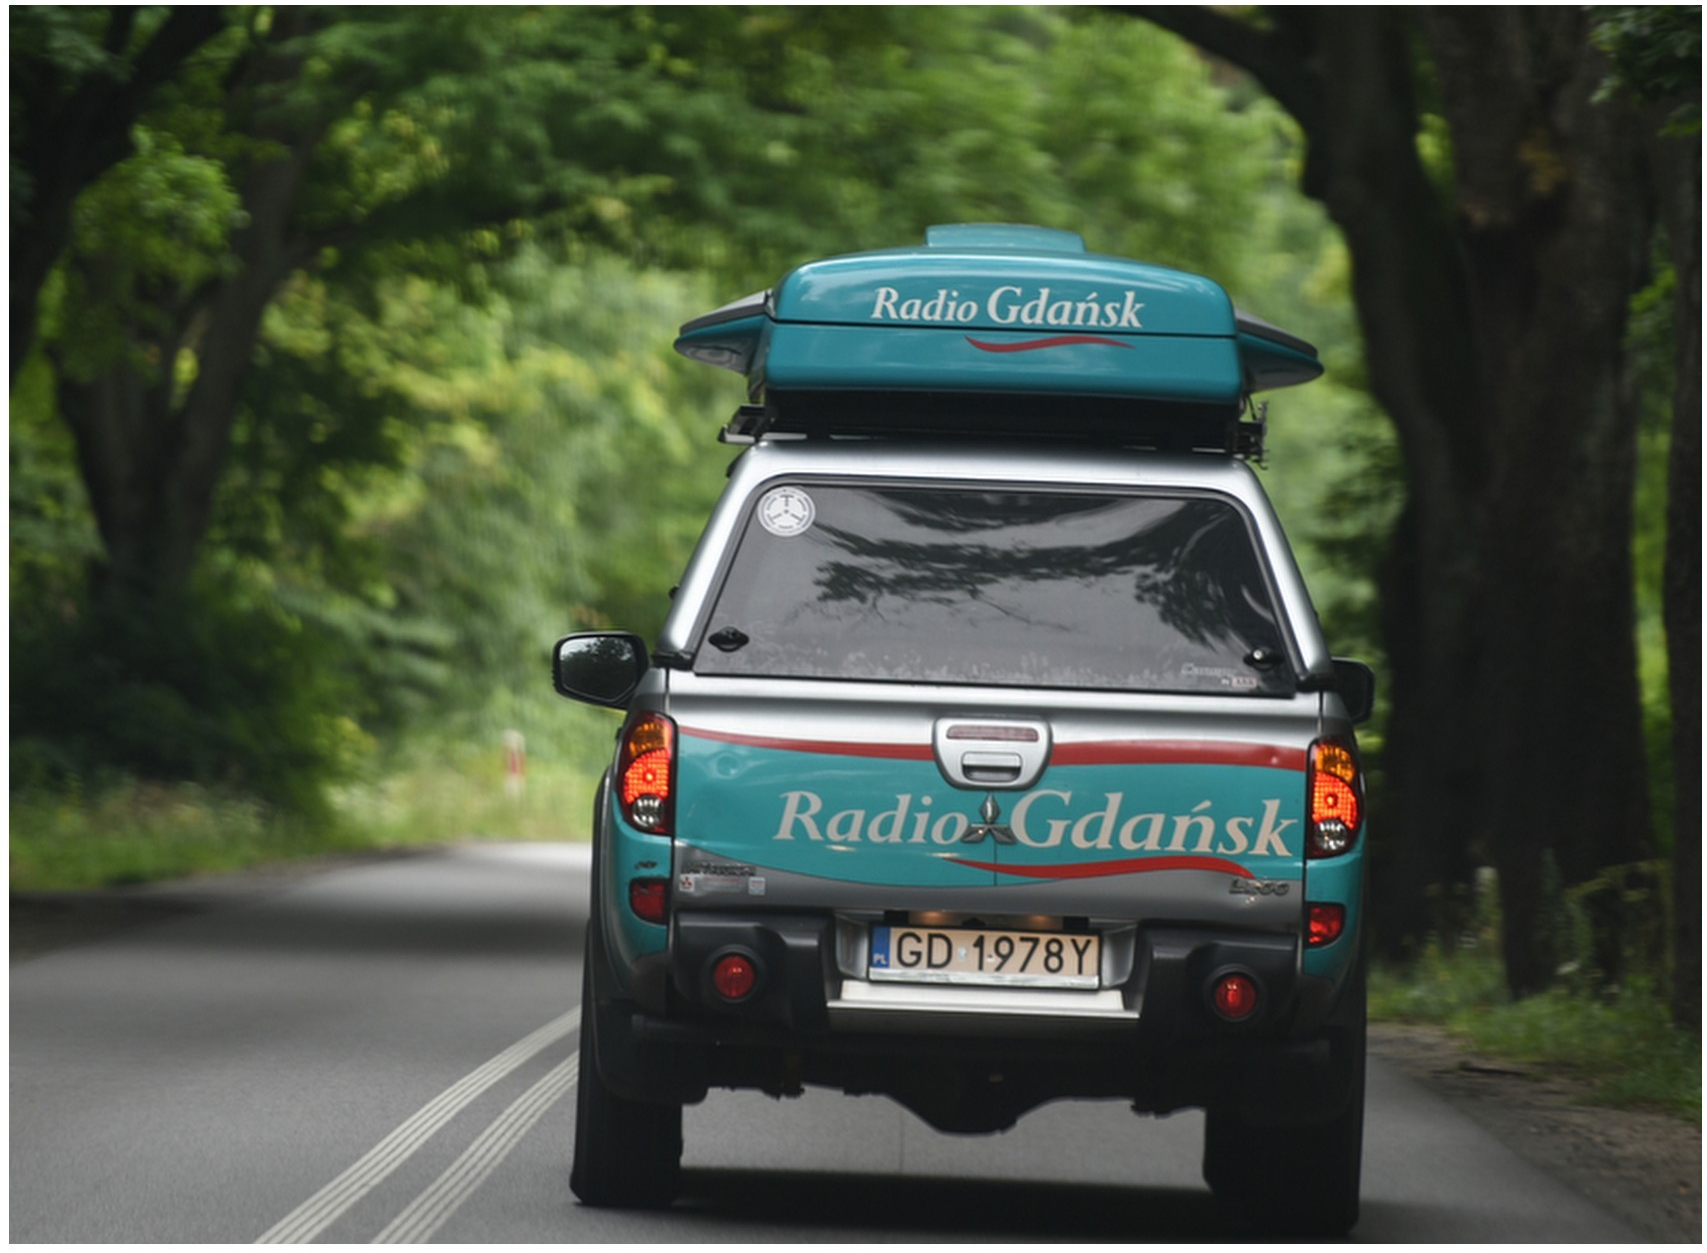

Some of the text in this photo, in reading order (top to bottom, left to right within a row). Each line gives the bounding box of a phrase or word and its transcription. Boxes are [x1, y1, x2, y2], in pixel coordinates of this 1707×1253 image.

[870, 285, 1145, 328] Radio Gdańsk
[772, 789, 1298, 856] Radio Gdańsk
[873, 952, 887, 965] PL
[897, 931, 1092, 976] GD 1978Y
